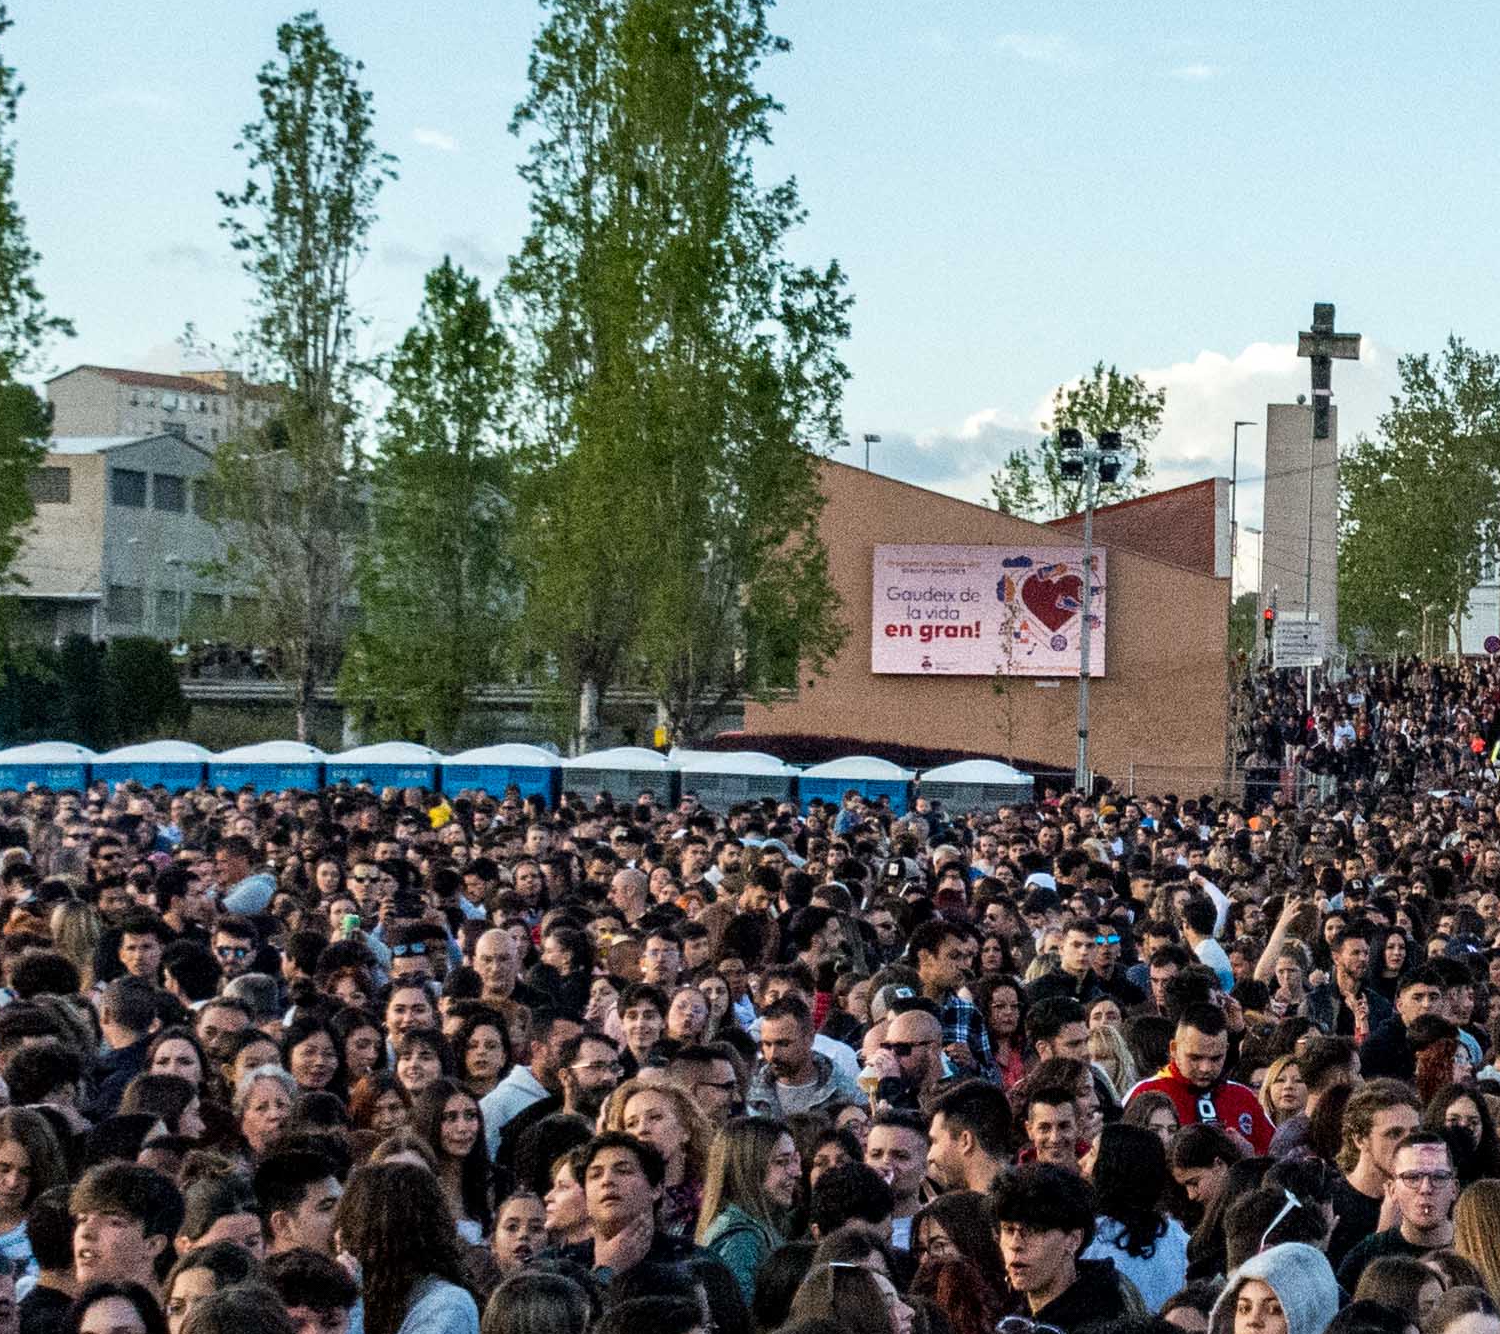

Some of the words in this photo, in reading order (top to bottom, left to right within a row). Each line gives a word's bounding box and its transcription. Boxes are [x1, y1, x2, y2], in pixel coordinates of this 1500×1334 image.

[886, 586, 955, 601] Gaudeix
[959, 586, 982, 602] de
[906, 604, 921, 620] la
[925, 605, 960, 620] vida
[884, 624, 914, 638] en
[919, 621, 981, 643] gran!
